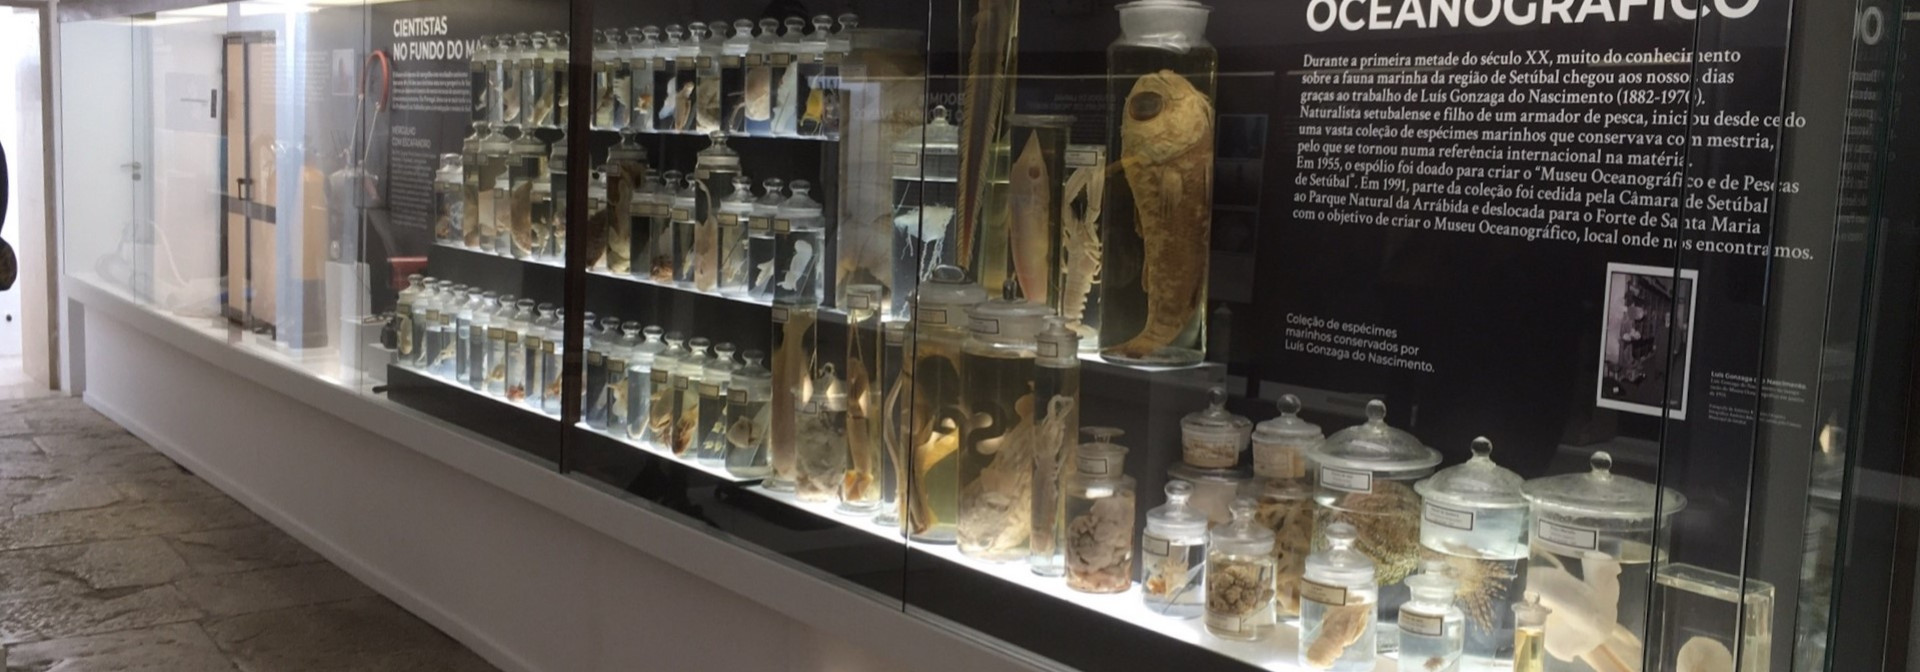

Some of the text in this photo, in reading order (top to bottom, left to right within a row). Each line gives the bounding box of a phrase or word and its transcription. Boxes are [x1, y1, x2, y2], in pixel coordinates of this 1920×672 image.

[393, 16, 448, 37] CIENTISTAS
[393, 42, 408, 61] NO
[410, 40, 445, 60] FUNDO
[447, 39, 463, 59] DO
[1303, 54, 1349, 67] Durante
[1351, 58, 1358, 66] a
[1360, 53, 1412, 71] primeira
[1415, 52, 1460, 66] metade
[1462, 52, 1478, 65] do
[1481, 51, 1522, 65] século
[1525, 50, 1554, 67] XX,
[1557, 50, 1601, 64] muito
[1604, 49, 1622, 64] do
[1302, 68, 1735, 88] sobre a fauna marinha da região de Setúbal chegou aos nosso dias
[1301, 92, 1335, 106] graças
[1337, 92, 1351, 101] ao
[1352, 88, 1402, 101] trabalho
[1404, 89, 1419, 102] de
[1421, 89, 1447, 102] Luís
[1450, 87, 1505, 106] Gonzaga
[1508, 89, 1526, 102] do
[1528, 89, 1614, 103] Nascimento
[1300, 105, 1361, 118] Naturalista
[1364, 106, 1432, 120] setubalense
[1434, 111, 1441, 120] e
[1443, 107, 1475, 121] filho
[1477, 108, 1493, 121] de
[1495, 112, 1518, 122] um
[1520, 109, 1581, 122] armador
[1584, 109, 1601, 123] de
[1604, 114, 1649, 127] pesca,
[1714, 111, 1760, 126] desde
[1299, 126, 1322, 135] uma
[1325, 126, 1353, 136] vasta
[1355, 124, 1398, 138] coleção
[1400, 125, 1415, 138] de
[1417, 126, 1479, 143] espécimes
[1482, 127, 1547, 142] marinhos
[1550, 132, 1575, 146] que
[1578, 133, 1663, 145] conservava
[1707, 133, 1775, 151] mestria,
[1298, 139, 1321, 154] pelo
[1322, 144, 1342, 156] que
[1344, 145, 1355, 153] se
[1358, 144, 1398, 155] tornou
[1401, 147, 1436, 156] numa
[1438, 144, 1503, 159] referência
[1507, 146, 1602, 163] internacional
[1605, 154, 1624, 164] na
[1297, 156, 1315, 168] Em
[1317, 157, 1343, 172] 1955,
[1345, 162, 1353, 170] o
[1354, 159, 1395, 177] espólio
[1398, 160, 1414, 174] foi
[1416, 161, 1454, 175] doado
[1456, 167, 1485, 180] para
[1487, 165, 1521, 179] criar
[1523, 170, 1532, 179] o
[1707, 179, 1717, 188] e
[1720, 174, 1740, 190] de
[1295, 173, 1308, 185] de
[1361, 176, 1380, 189] Em
[1383, 178, 1410, 194] 1991,
[1412, 183, 1445, 196] parte
[1447, 181, 1462, 194] da
[1464, 182, 1513, 199] coleção
[1515, 184, 1534, 199] foi
[1537, 186, 1582, 201] cedida
[1585, 189, 1616, 206] pela
[1619, 189, 1679, 207] Câmara
[1685, 194, 1704, 209] de
[1707, 195, 1769, 212] Setúbal
[1294, 193, 1307, 201] ao
[1309, 190, 1347, 208] Parque
[1349, 193, 1394, 208] Natural
[1396, 196, 1410, 209] da
[1413, 198, 1469, 213] Arrábida
[1472, 205, 1480, 214] e
[1481, 201, 1545, 218] deslocada
[1548, 210, 1580, 223] para
[1583, 212, 1593, 222] o
[1596, 209, 1637, 225] Forte
[1640, 211, 1658, 226] de
[1711, 216, 1761, 233] Maria
[1293, 210, 1316, 219] com
[1318, 212, 1325, 220] o
[1327, 209, 1374, 225] objetivo
[1375, 212, 1390, 225] de
[1391, 215, 1421, 228] criar
[1423, 220, 1432, 228] o
[1433, 217, 1476, 232] Museu
[1479, 220, 1581, 244] Oceanográfico,
[1584, 227, 1618, 243] local
[1622, 232, 1660, 247] onde
[1286, 313, 1398, 339] Coleção de espécimes
[1285, 327, 1419, 356] marinhos conservados por
[1285, 339, 1435, 373] Luís Gonzaga do Nascimento.
